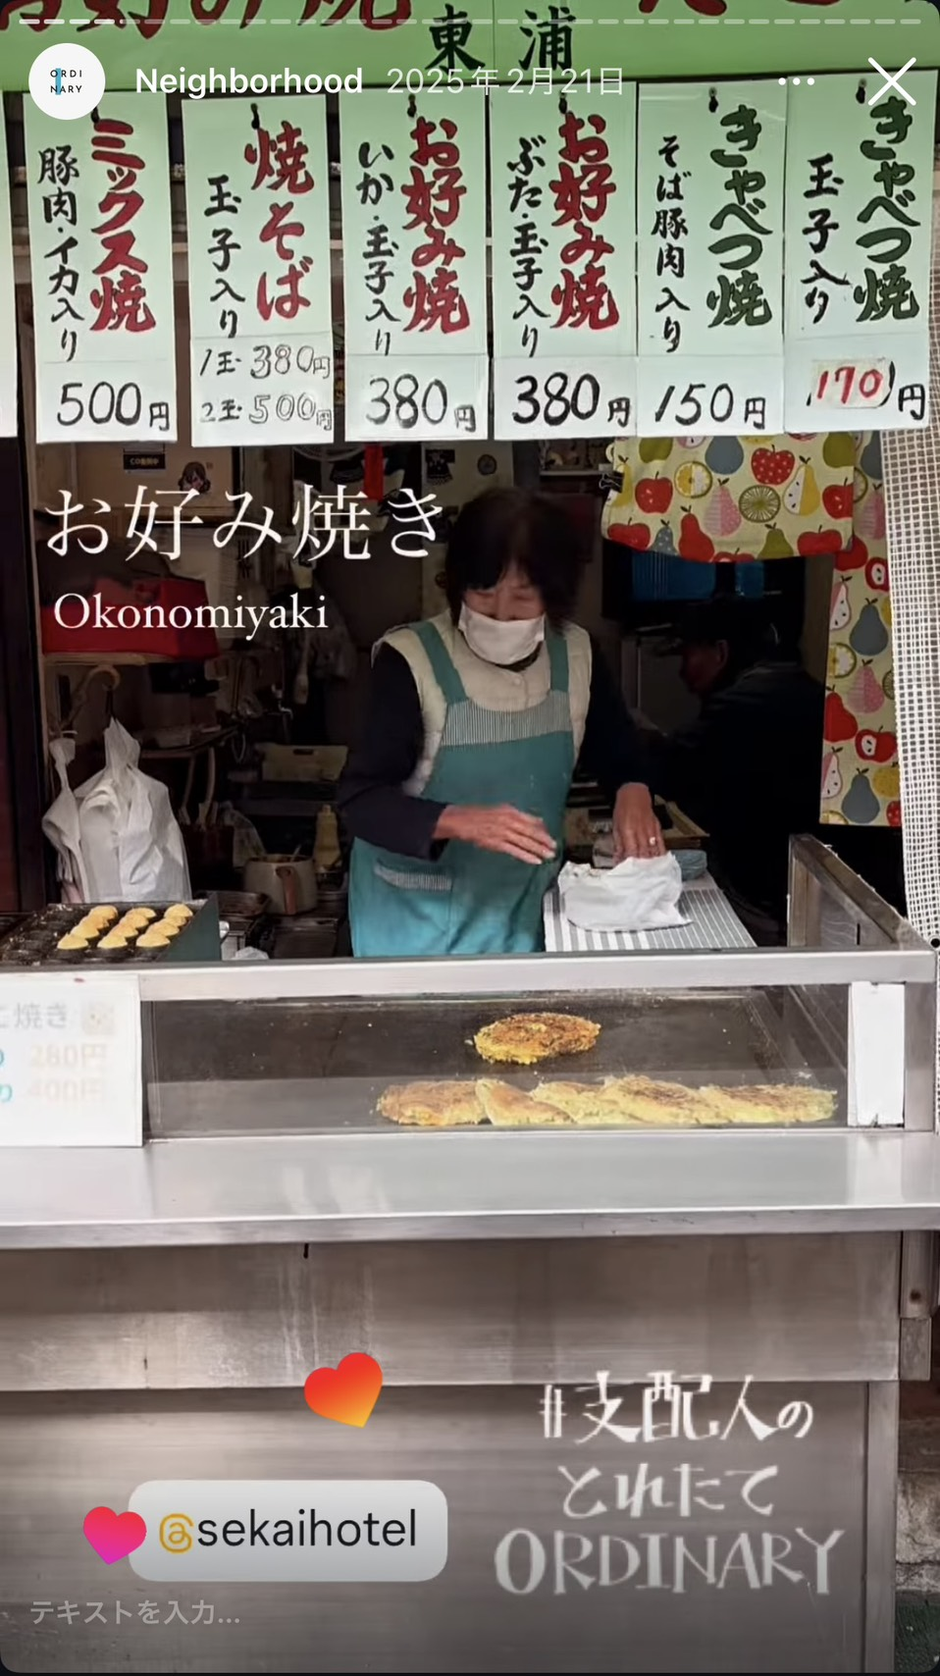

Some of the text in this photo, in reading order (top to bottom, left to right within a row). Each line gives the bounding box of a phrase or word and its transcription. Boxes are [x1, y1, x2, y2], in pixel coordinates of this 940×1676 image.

[90, 118, 156, 333] ミックス焼
[204, 174, 246, 338] 玉子入り
[244, 120, 315, 320] 焼そば
[401, 116, 470, 335] お好み焼
[549, 110, 620, 331] お好み焼
[651, 135, 692, 353] そば豚肉入り
[706, 104, 774, 328] きゃべつ焼
[800, 153, 851, 324] 玉子入り
[853, 95, 922, 322] きゃべつ焼
[57, 381, 170, 431] 500円
[365, 373, 477, 432] 380円
[512, 371, 631, 427] 380円
[654, 383, 767, 430] 150円
